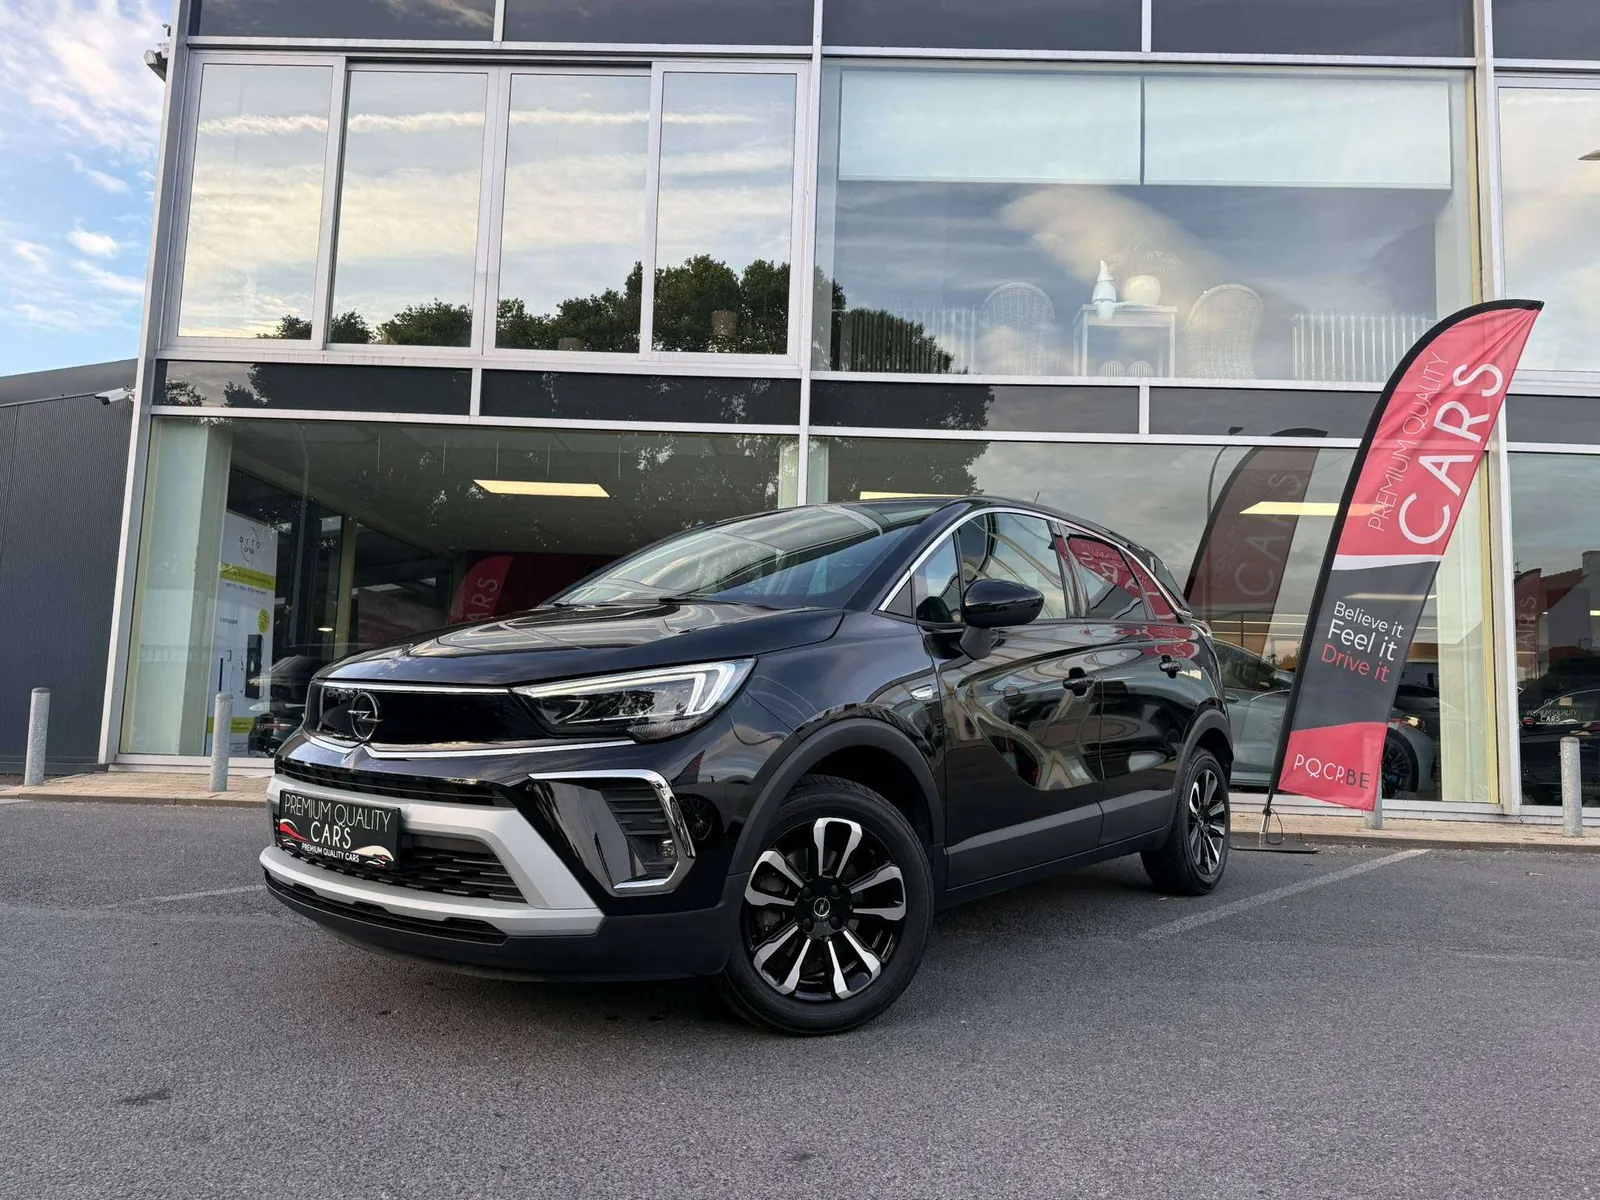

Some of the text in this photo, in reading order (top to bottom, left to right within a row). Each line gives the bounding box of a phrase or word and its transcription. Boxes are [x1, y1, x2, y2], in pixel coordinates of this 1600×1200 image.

[1367, 351, 1449, 532] PREMIUM QUALITY
[1399, 363, 1503, 545] CARS
[1327, 618, 1397, 661] Feel it
[1334, 601, 1404, 639] Believe it
[1321, 643, 1391, 683] Drive it
[284, 793, 392, 832] PREMIUM QUALITY
[301, 842, 360, 863] PREMIUM QUALITY CARS
[310, 821, 351, 849] CARS
